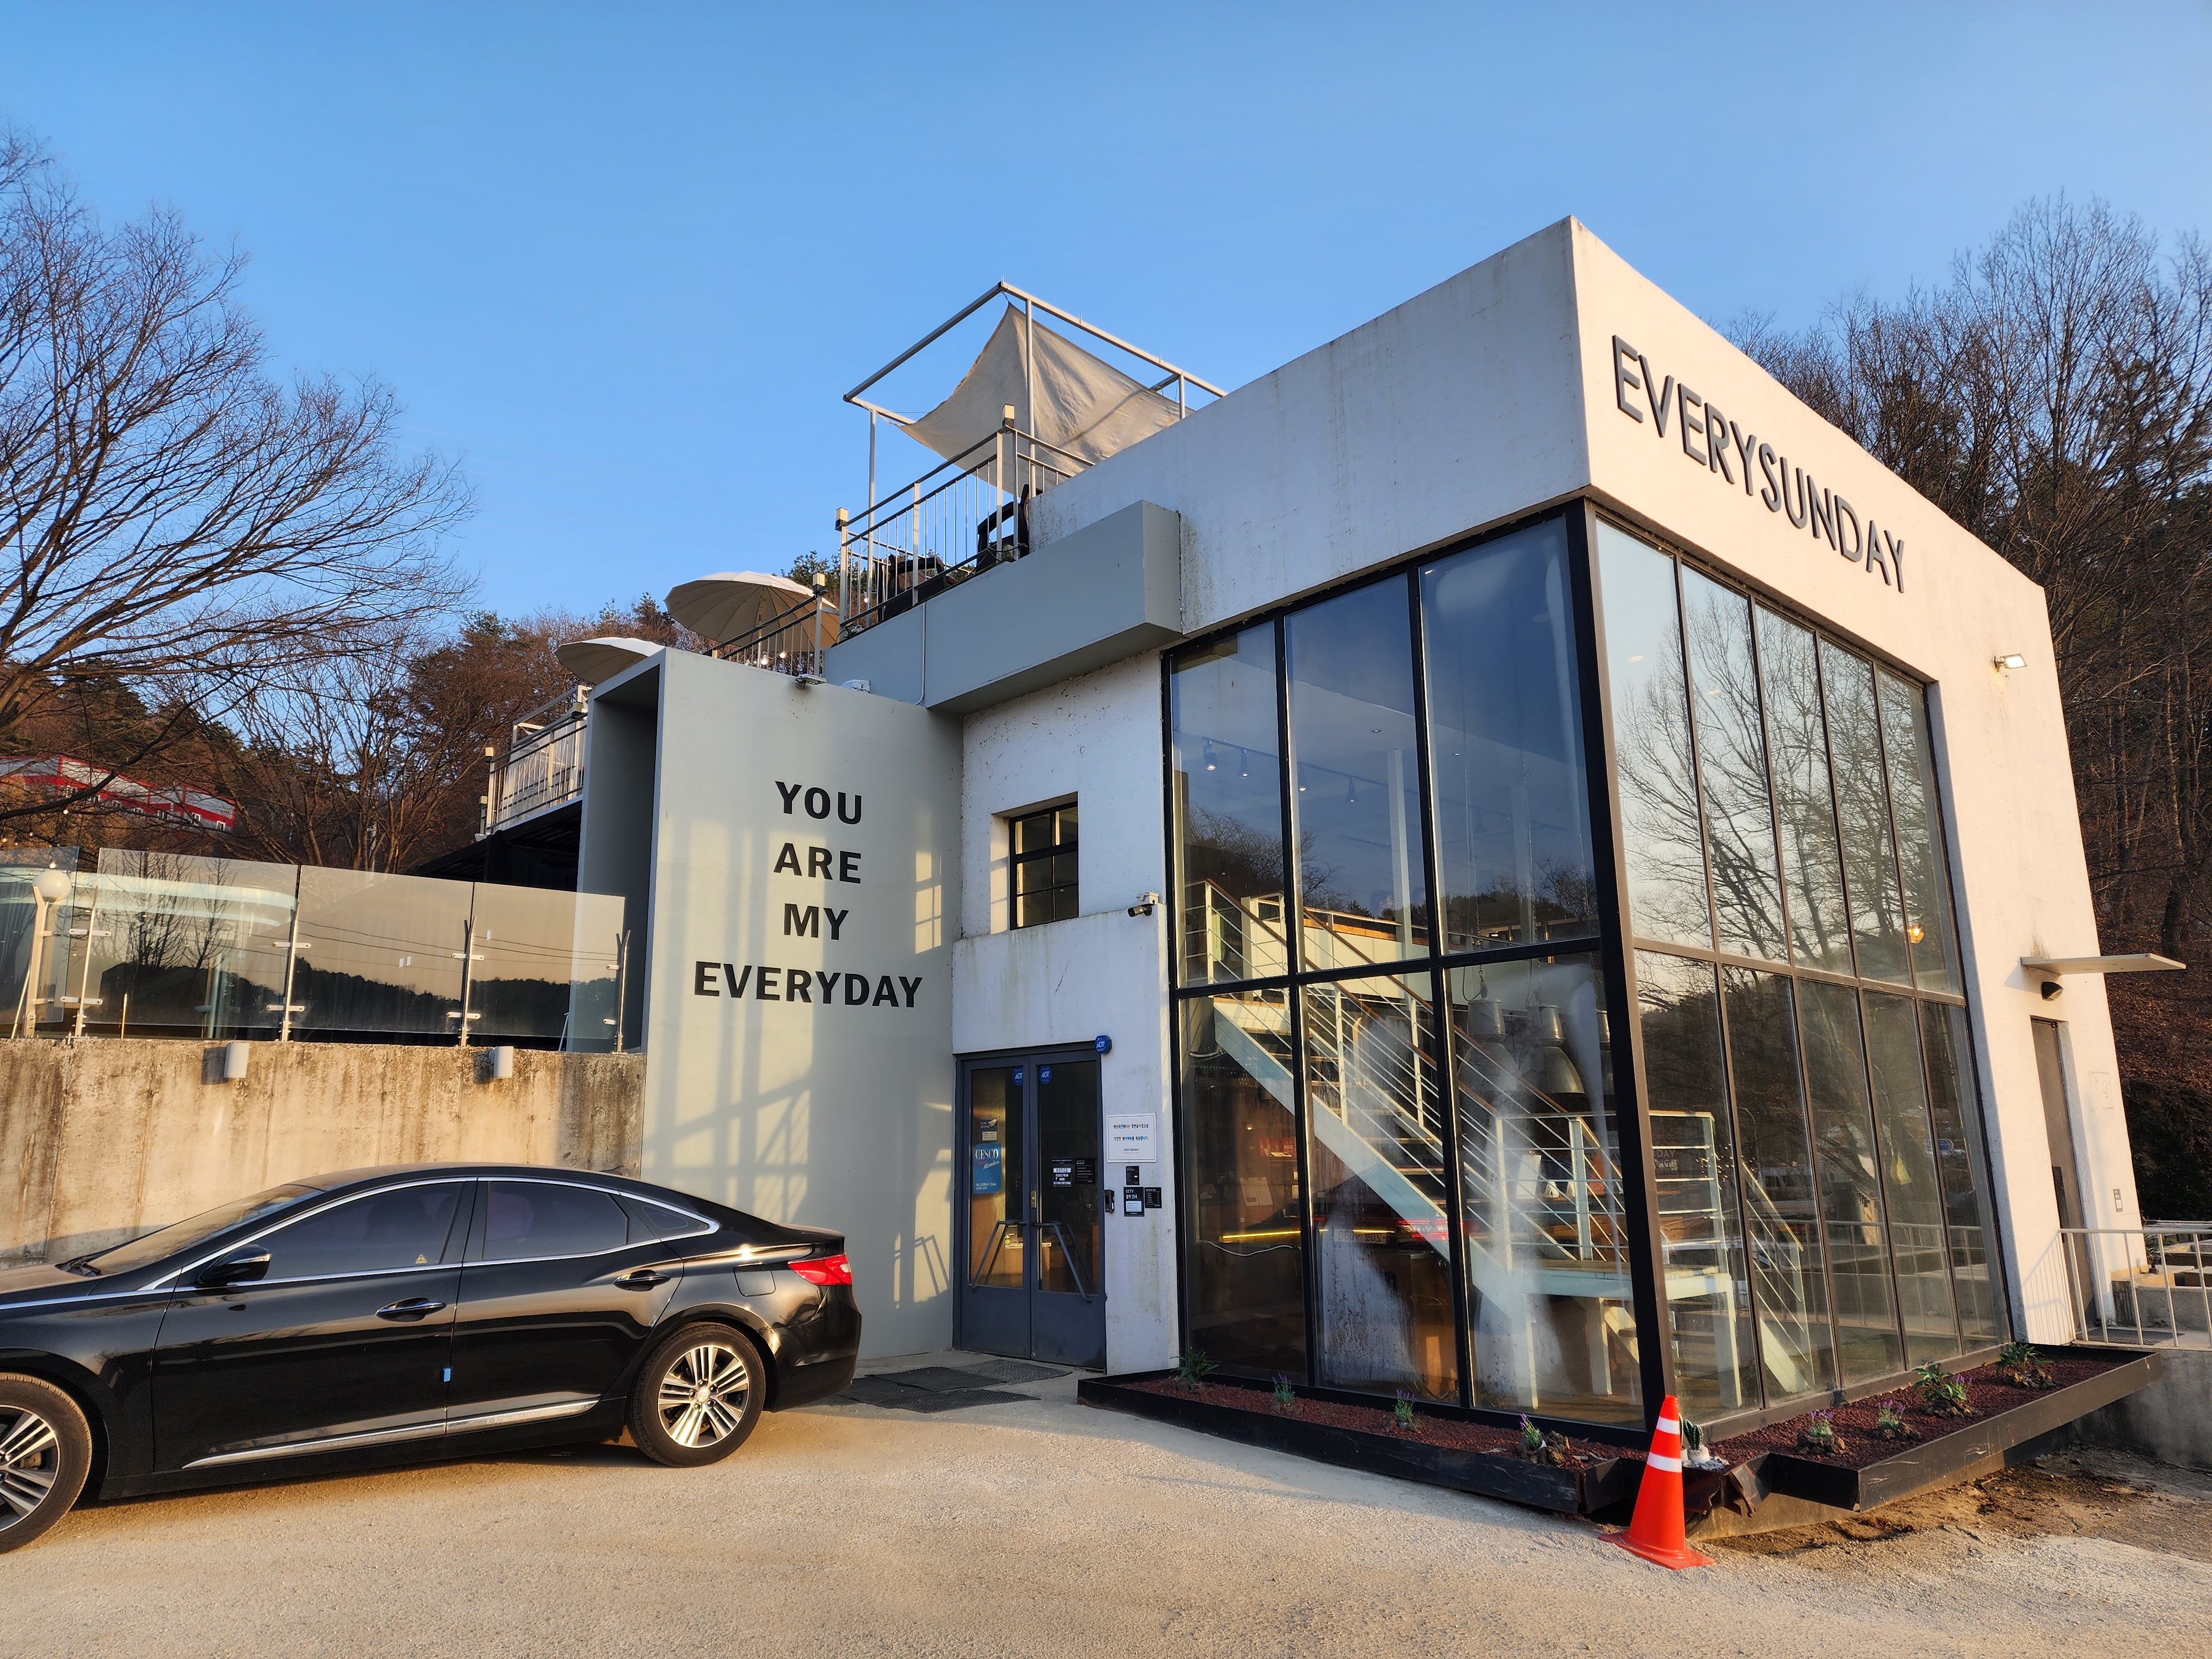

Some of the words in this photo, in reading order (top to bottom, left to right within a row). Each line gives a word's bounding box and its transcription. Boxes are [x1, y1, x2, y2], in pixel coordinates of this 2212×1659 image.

[1612, 334, 1905, 593] EVERYSUNDAY
[775, 780, 862, 825] YOU
[773, 842, 862, 884] ARE
[783, 903, 849, 941] MY
[694, 961, 923, 1008] EVERYDAY
[975, 1148, 999, 1160] CESCO
